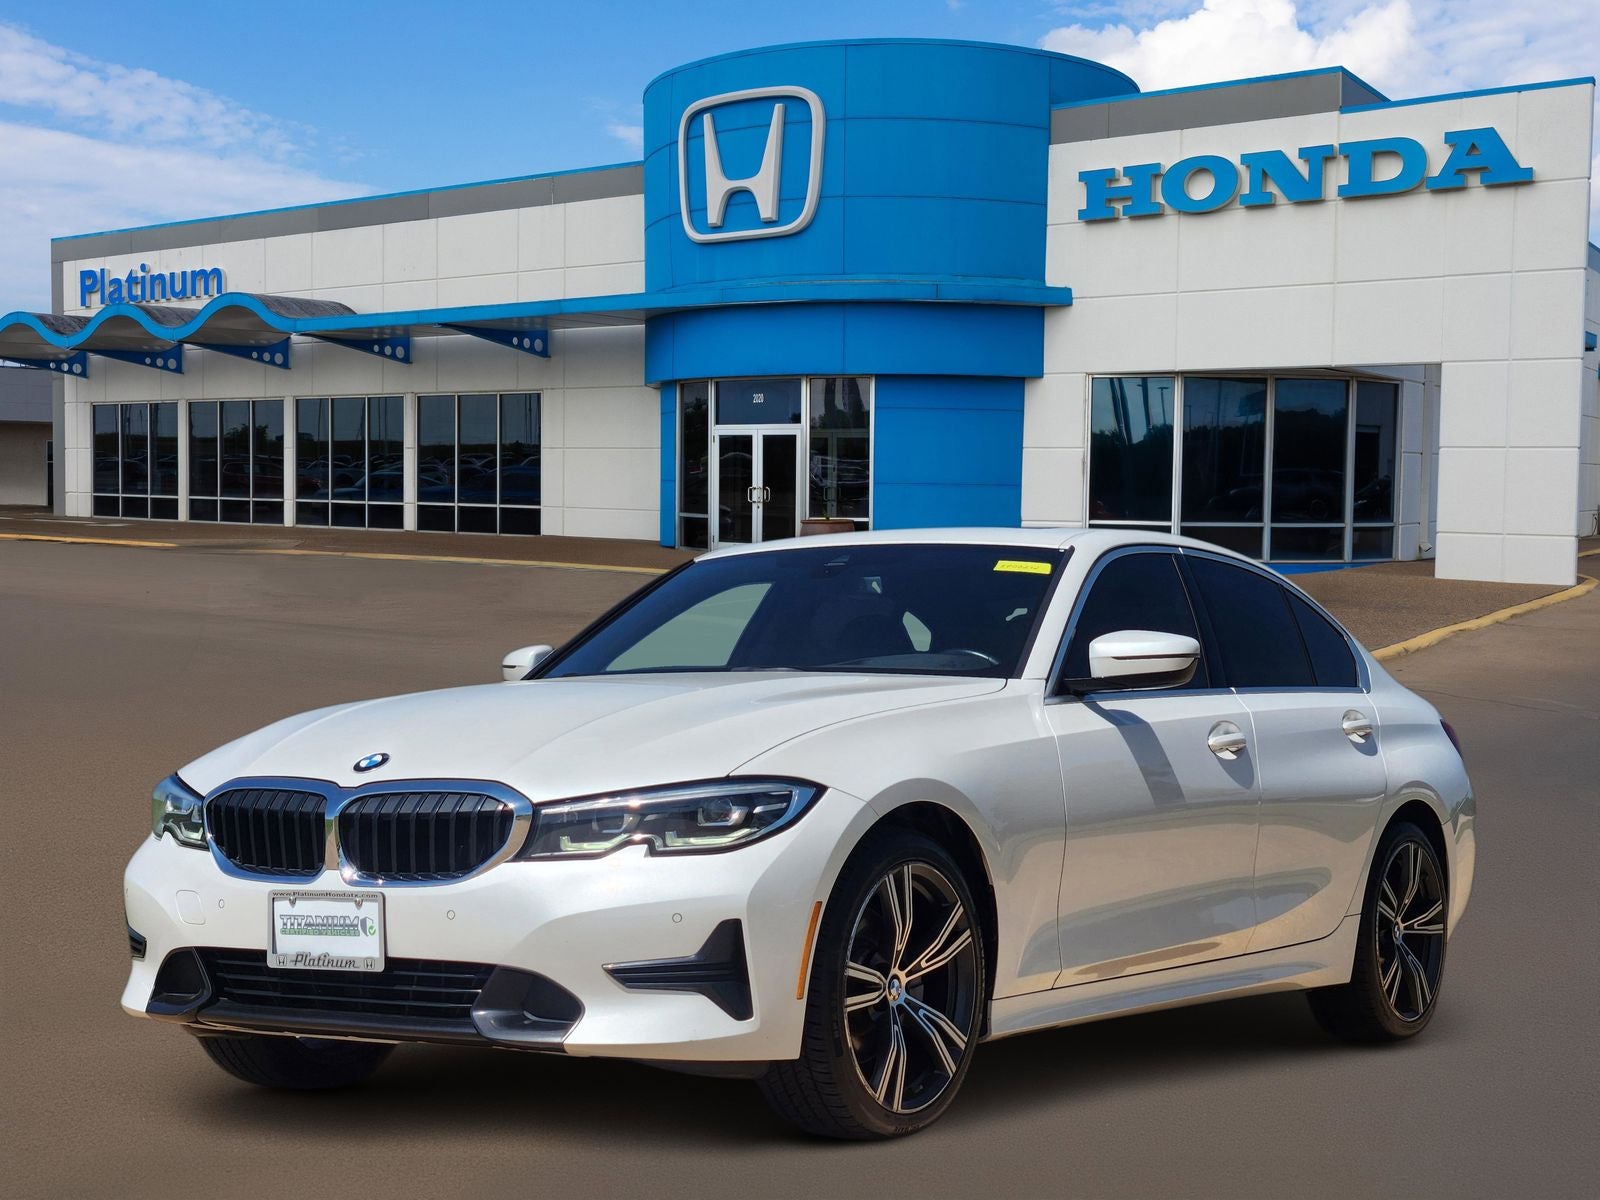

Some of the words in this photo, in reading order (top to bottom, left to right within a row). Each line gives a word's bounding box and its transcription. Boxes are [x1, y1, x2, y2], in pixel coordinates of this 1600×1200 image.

[1078, 127, 1534, 222] HONDA
[80, 263, 225, 307] Platinum
[280, 915, 360, 930] TITANIUM
[280, 928, 318, 936] CERTIFIED
[290, 951, 361, 969] Platinum
